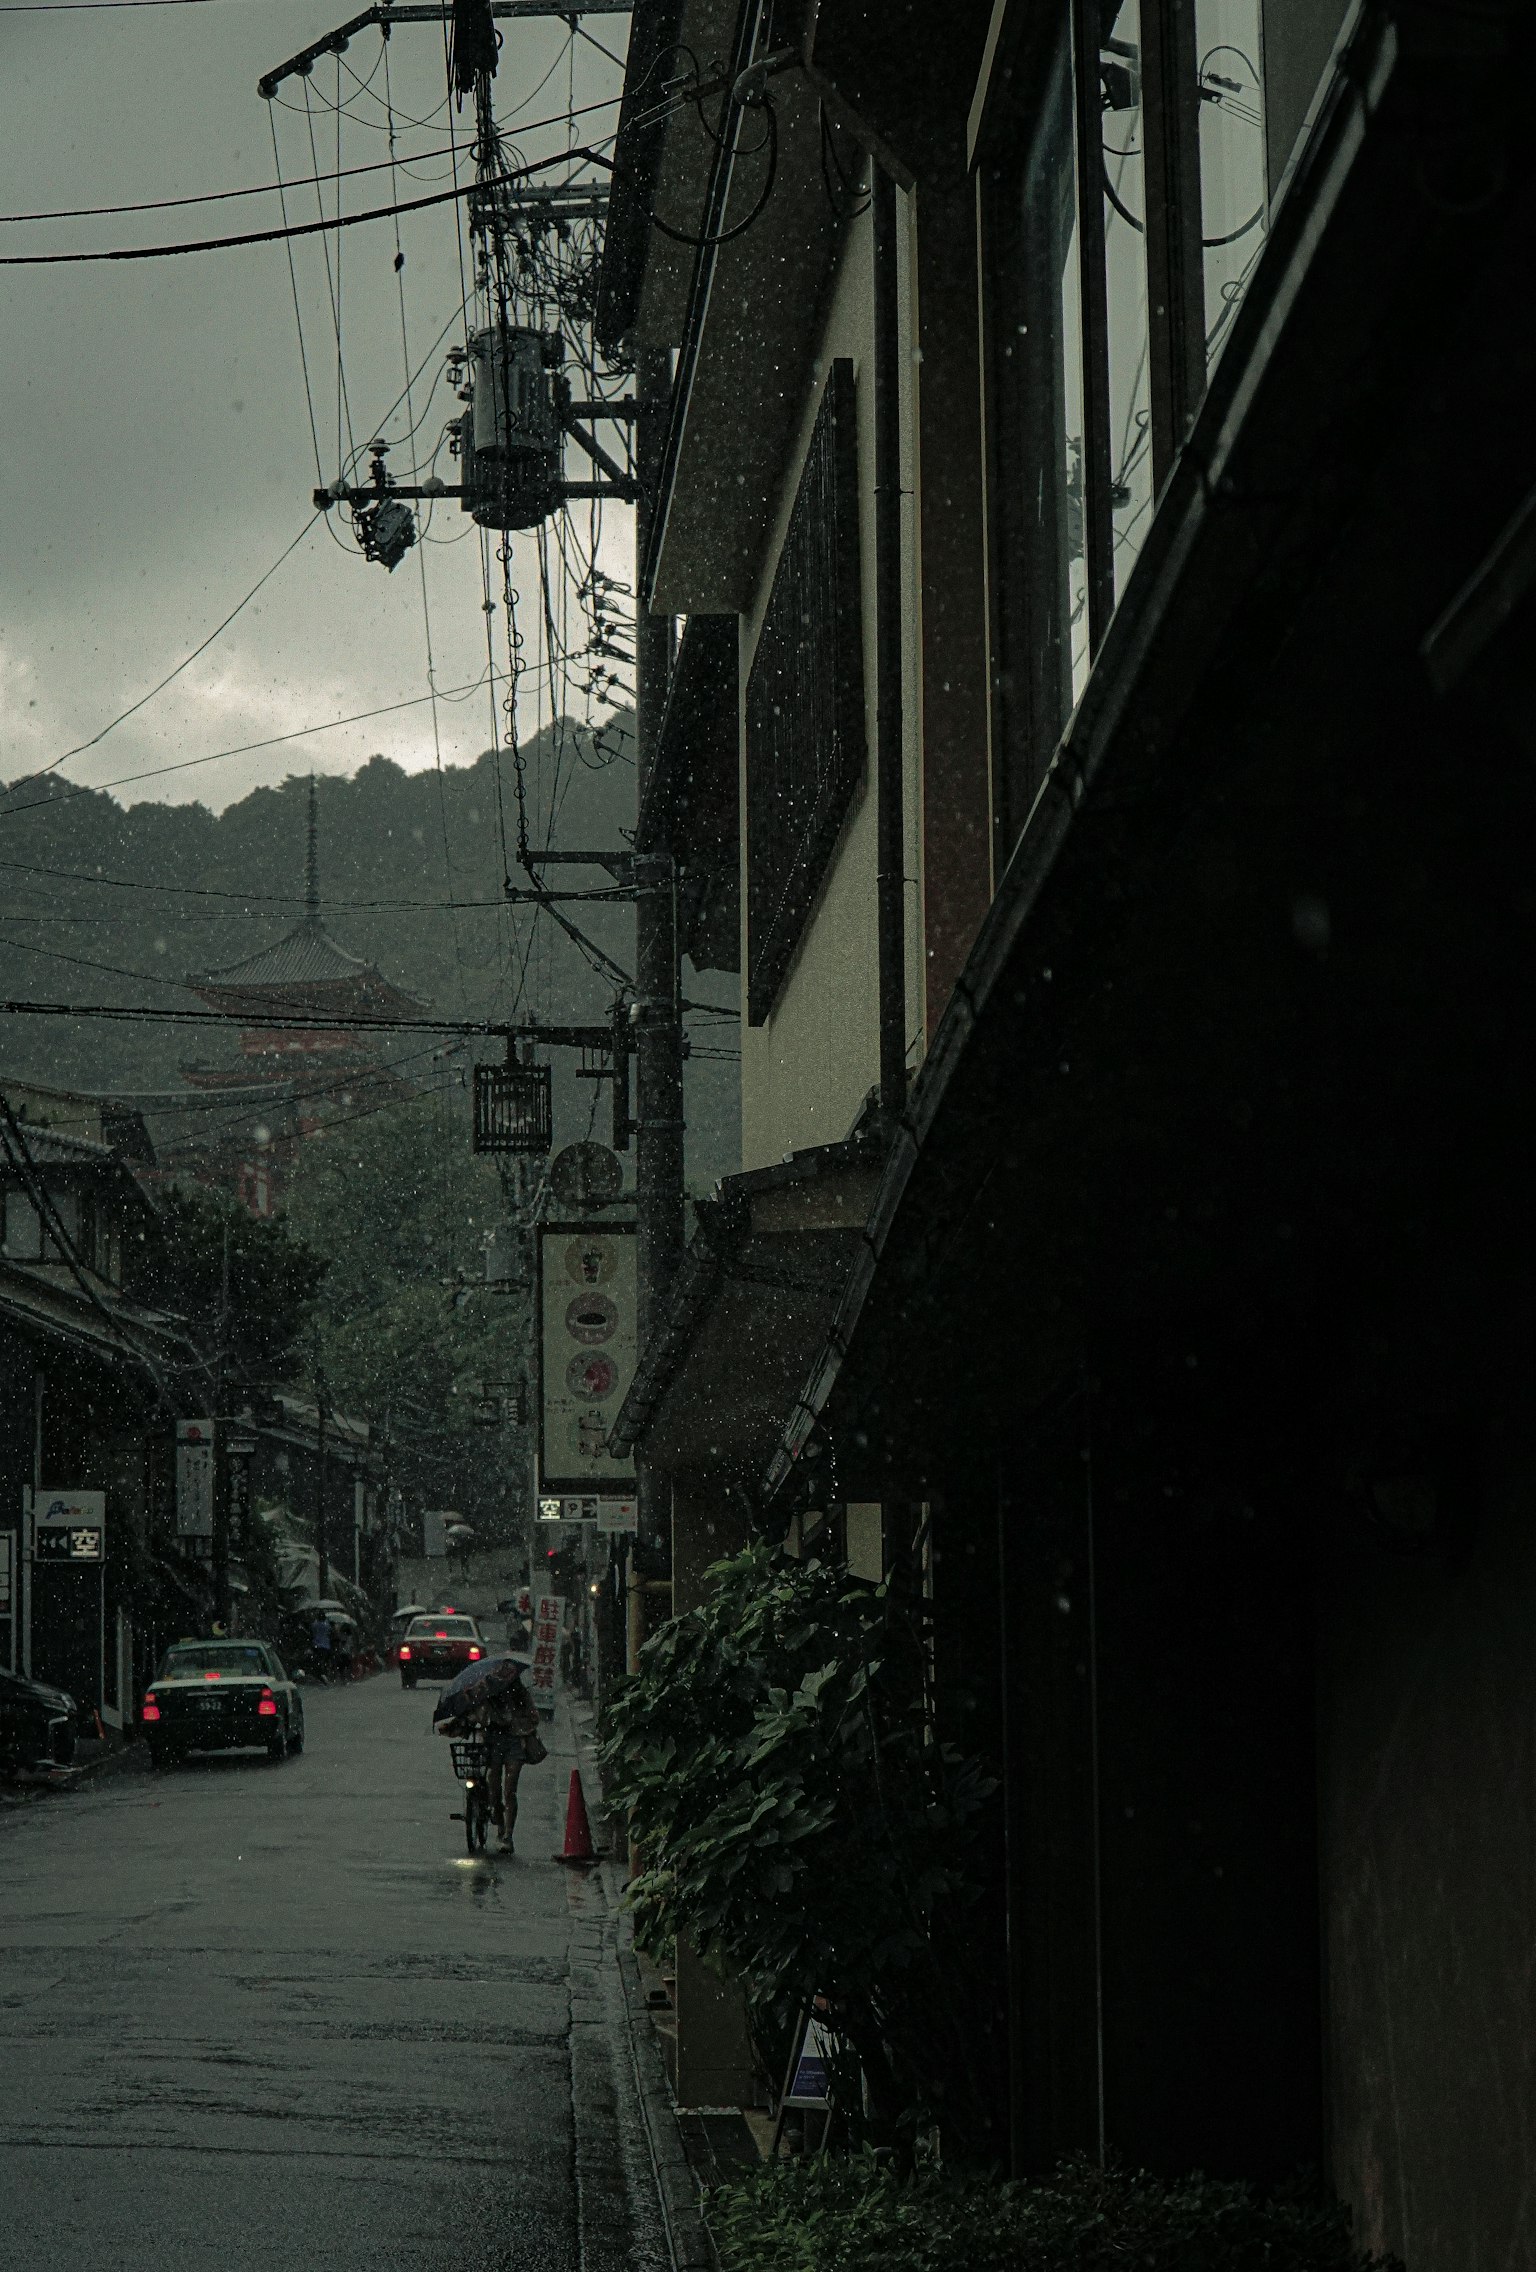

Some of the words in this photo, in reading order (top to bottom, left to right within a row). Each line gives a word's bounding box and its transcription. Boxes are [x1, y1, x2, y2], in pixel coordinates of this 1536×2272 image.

[540, 1499, 560, 1520] 空
[70, 1528, 100, 1558] 空
[533, 1599, 560, 1688] 駐車厳禁
